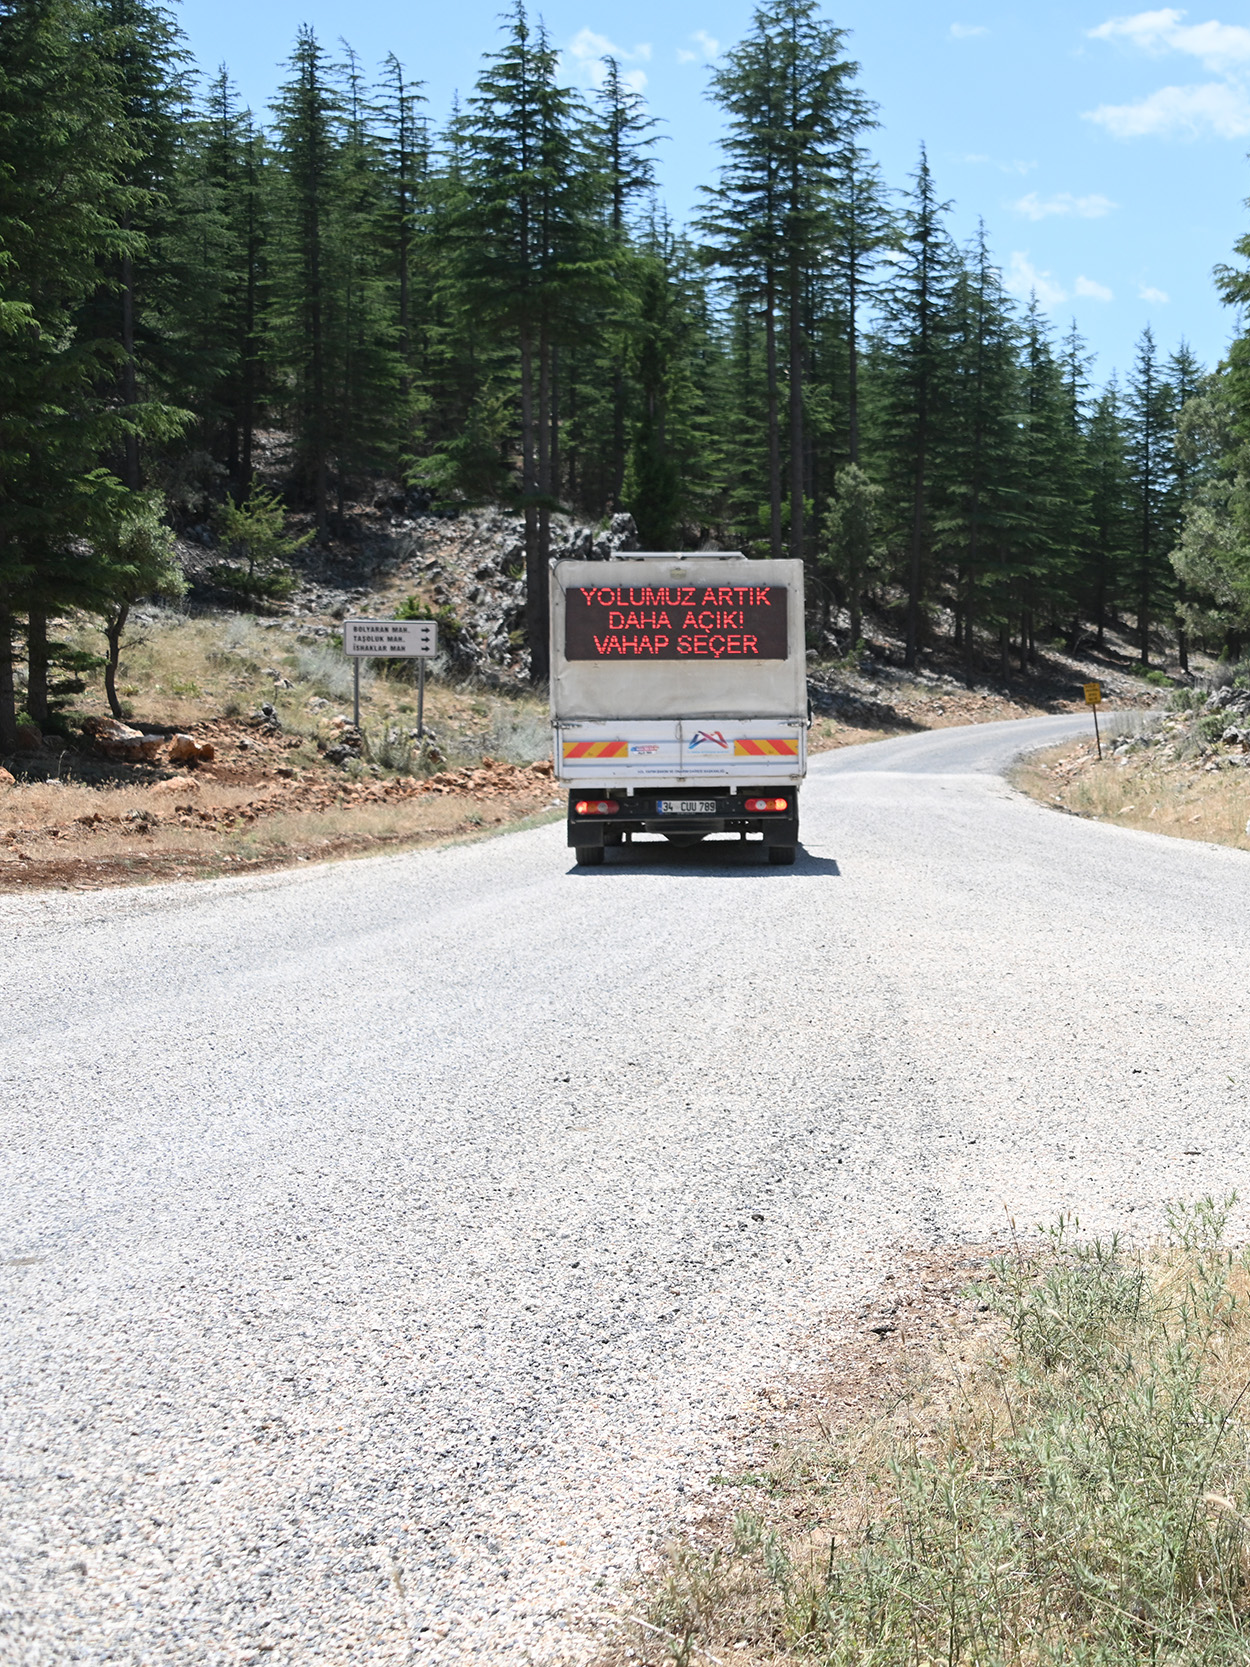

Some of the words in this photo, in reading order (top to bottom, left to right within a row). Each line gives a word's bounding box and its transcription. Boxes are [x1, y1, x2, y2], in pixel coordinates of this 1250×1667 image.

[579, 587, 697, 606] YOLUMUZ
[701, 587, 772, 606] ARTIK
[609, 611, 672, 630] DAHA
[682, 611, 744, 633] AÇIK!
[593, 635, 670, 655] VAHAP
[676, 635, 759, 658] SEÇER
[663, 802, 673, 812] 34
[699, 802, 716, 812] 789
